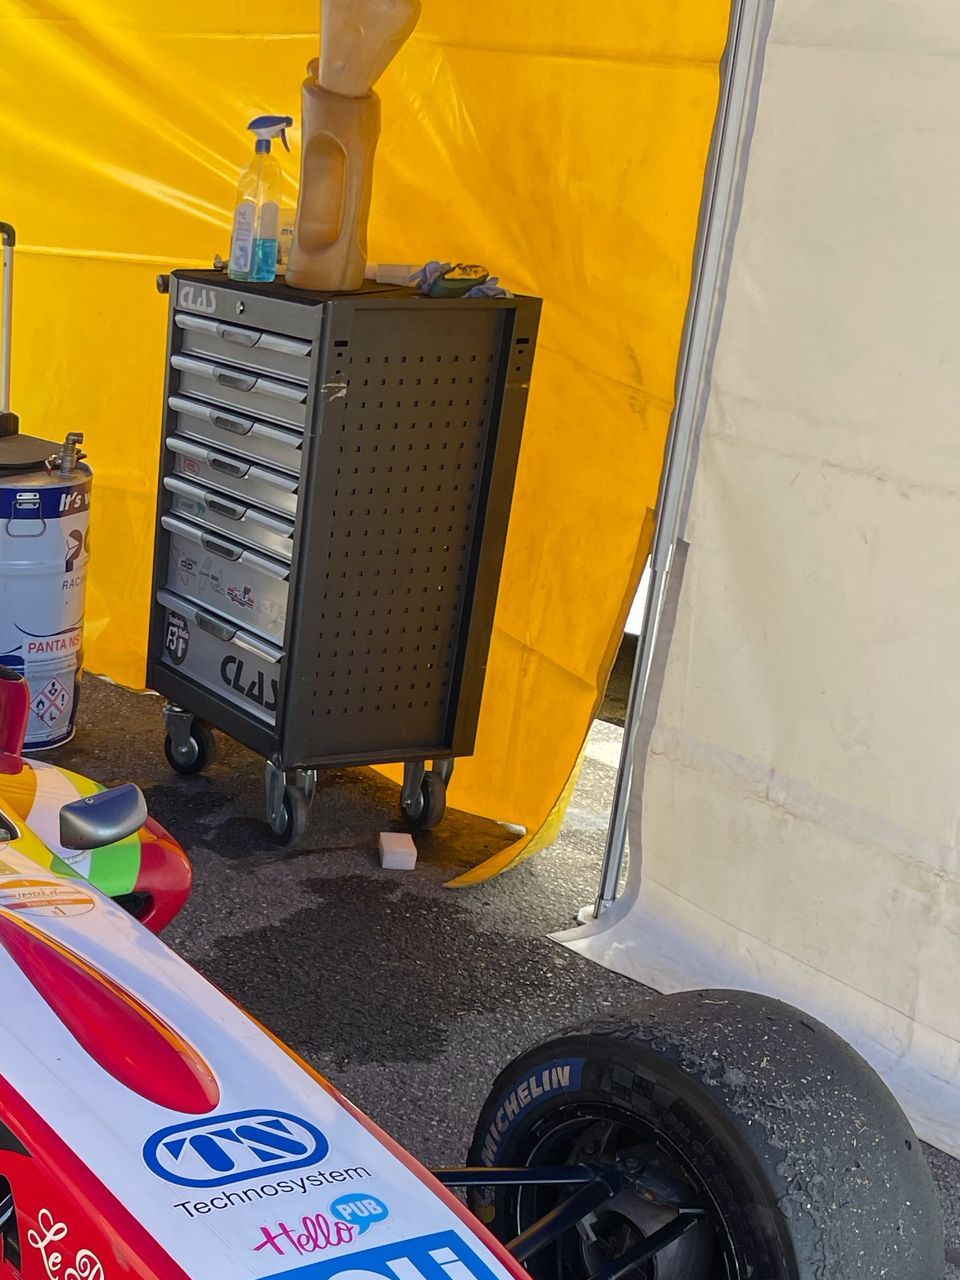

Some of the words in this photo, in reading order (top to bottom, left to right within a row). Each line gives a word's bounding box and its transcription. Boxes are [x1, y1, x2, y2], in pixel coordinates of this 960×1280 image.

[179, 286, 217, 314] CLAS
[28, 639, 68, 654] PANTA
[220, 655, 280, 712] CLAS
[480, 1064, 571, 1168] MICHELIN
[173, 1165, 373, 1218] Technosystem
[252, 1213, 355, 1256] Hello
[335, 1198, 383, 1221] PUB
